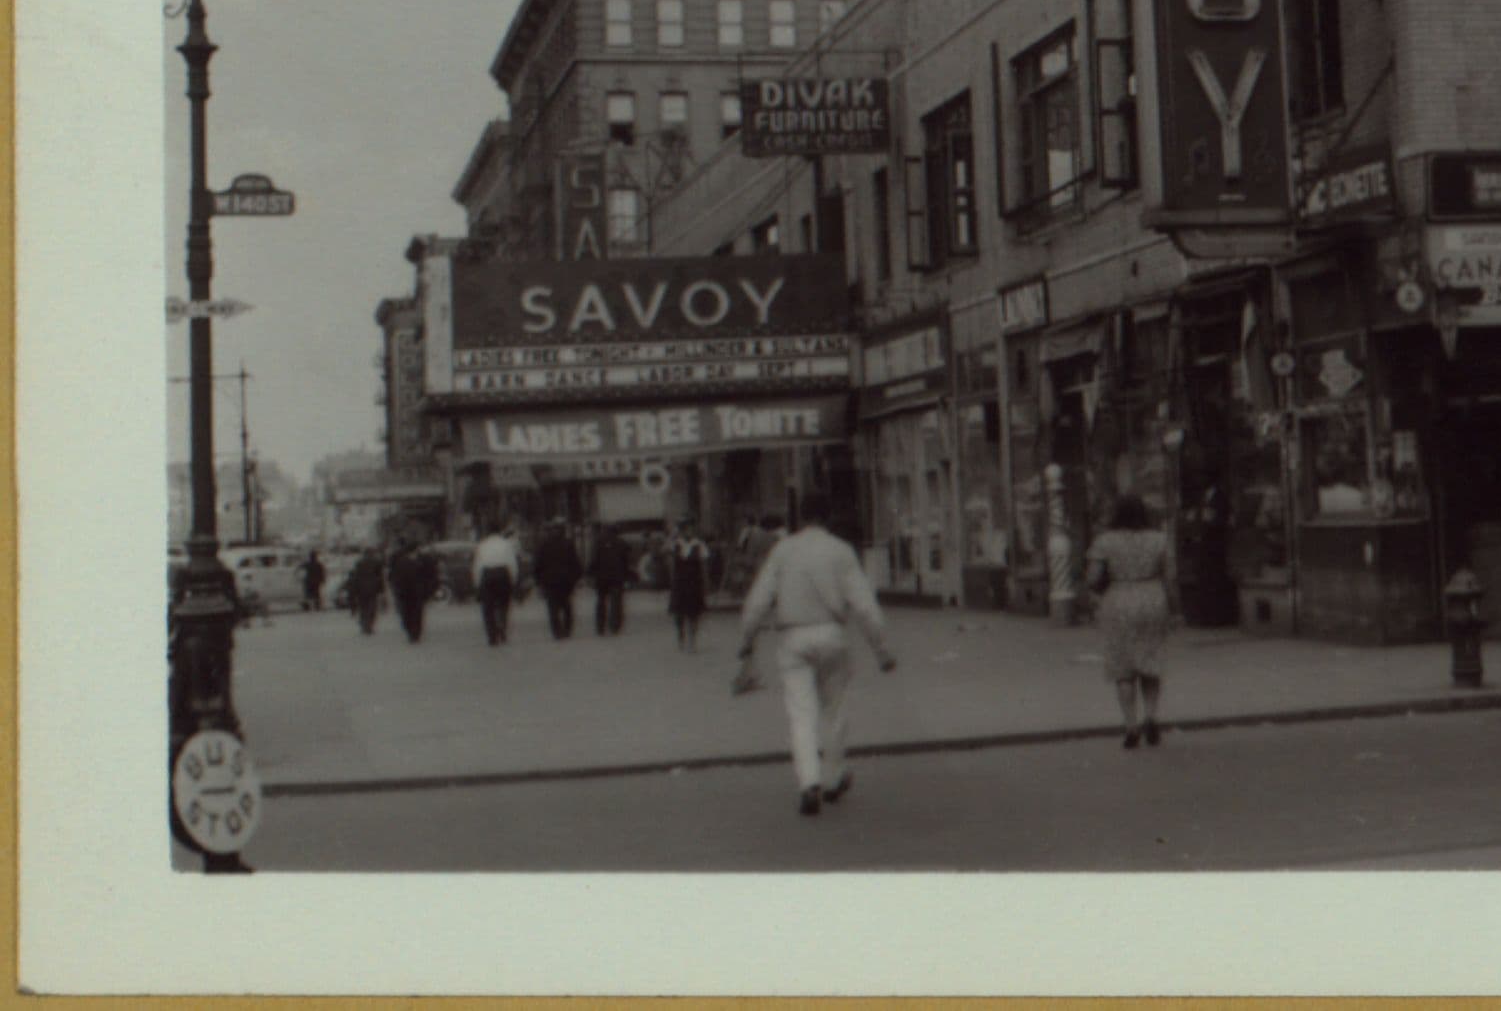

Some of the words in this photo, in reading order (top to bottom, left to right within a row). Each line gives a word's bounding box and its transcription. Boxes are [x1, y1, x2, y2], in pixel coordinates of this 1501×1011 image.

[761, 79, 875, 108] DIVAK
[754, 108, 886, 133] FURNITURE
[520, 277, 785, 334] SAVOY
[523, 346, 560, 365] FREE
[484, 418, 602, 454] LADIES
[612, 406, 701, 452] FREE
[184, 740, 245, 781] BUS
[188, 791, 254, 837] STOP
